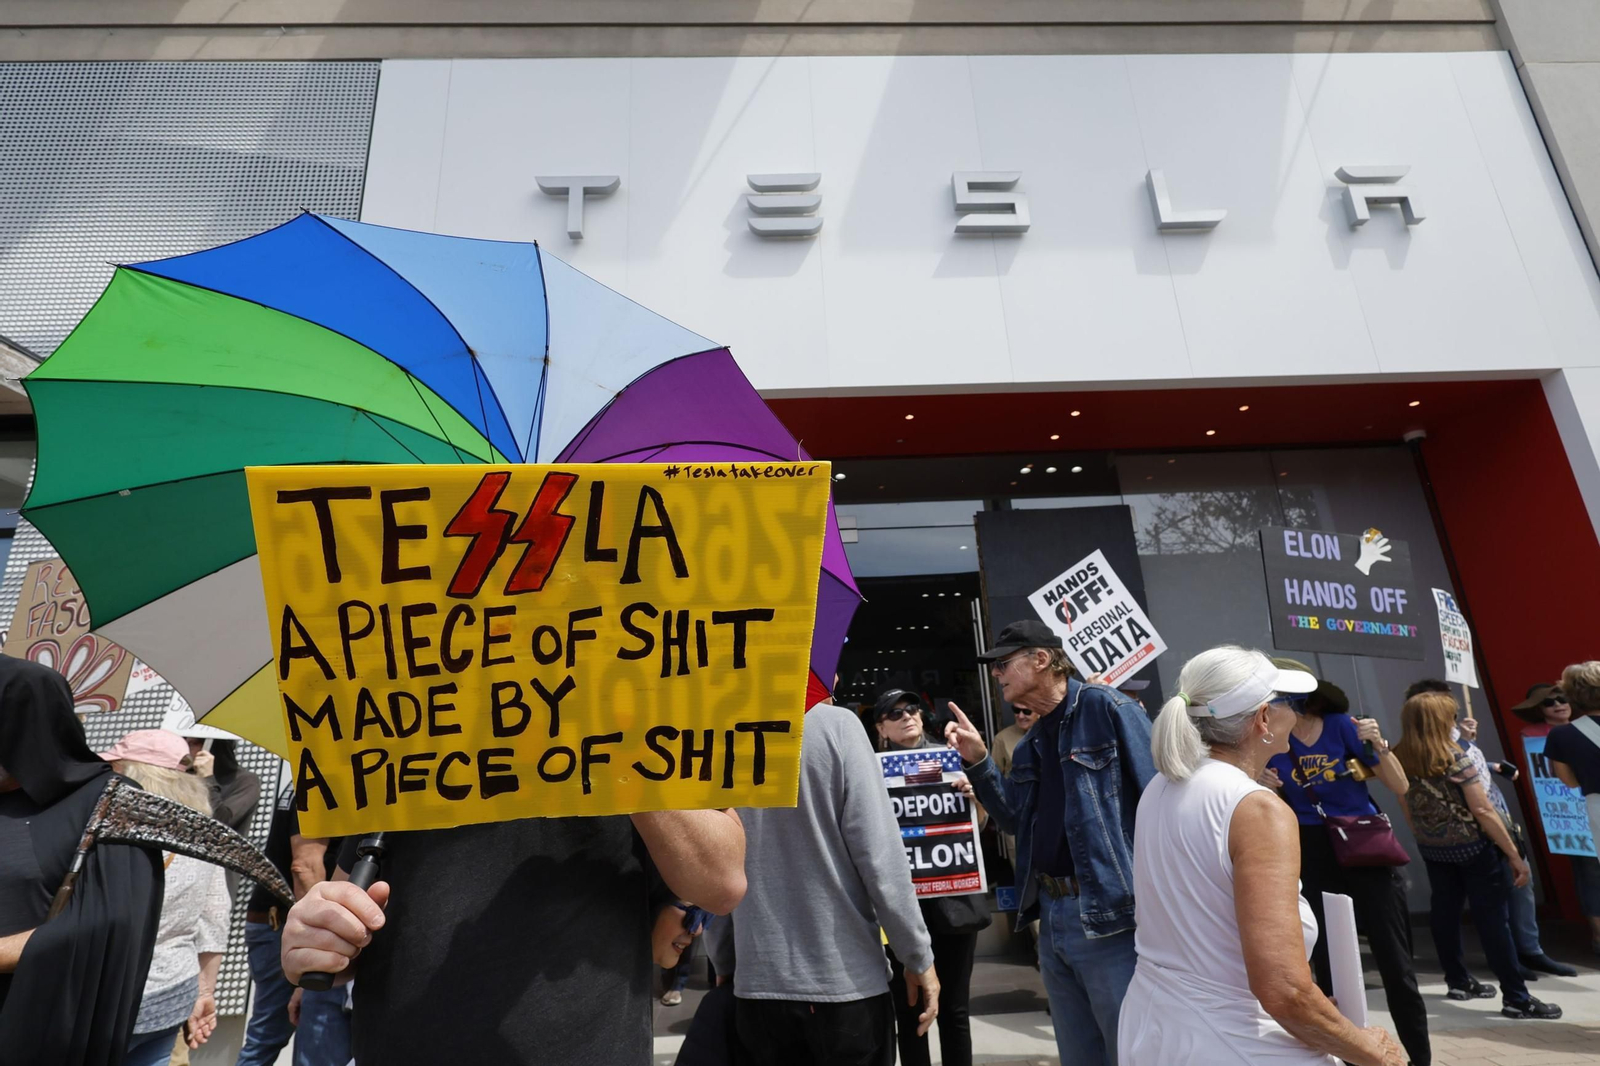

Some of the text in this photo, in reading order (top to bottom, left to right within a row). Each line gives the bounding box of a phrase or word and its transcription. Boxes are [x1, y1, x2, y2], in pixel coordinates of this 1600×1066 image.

[534, 165, 1426, 240] TESLA
[1284, 529, 1341, 561] ELON
[1042, 562, 1099, 606] HANDS
[1055, 575, 1114, 624] OFF!
[1284, 577, 1407, 615] HANDS OFF
[279, 600, 776, 680] A PIECE OF SHIT
[1068, 601, 1133, 651] PERSONAL
[1080, 617, 1151, 674] DATA
[1288, 615, 1418, 638] THE GOVERNMENT
[283, 683, 463, 743] MADE
[490, 675, 576, 738] BY
[296, 720, 792, 811] A PIECE OF SHIT
[891, 791, 966, 819] DEPORT
